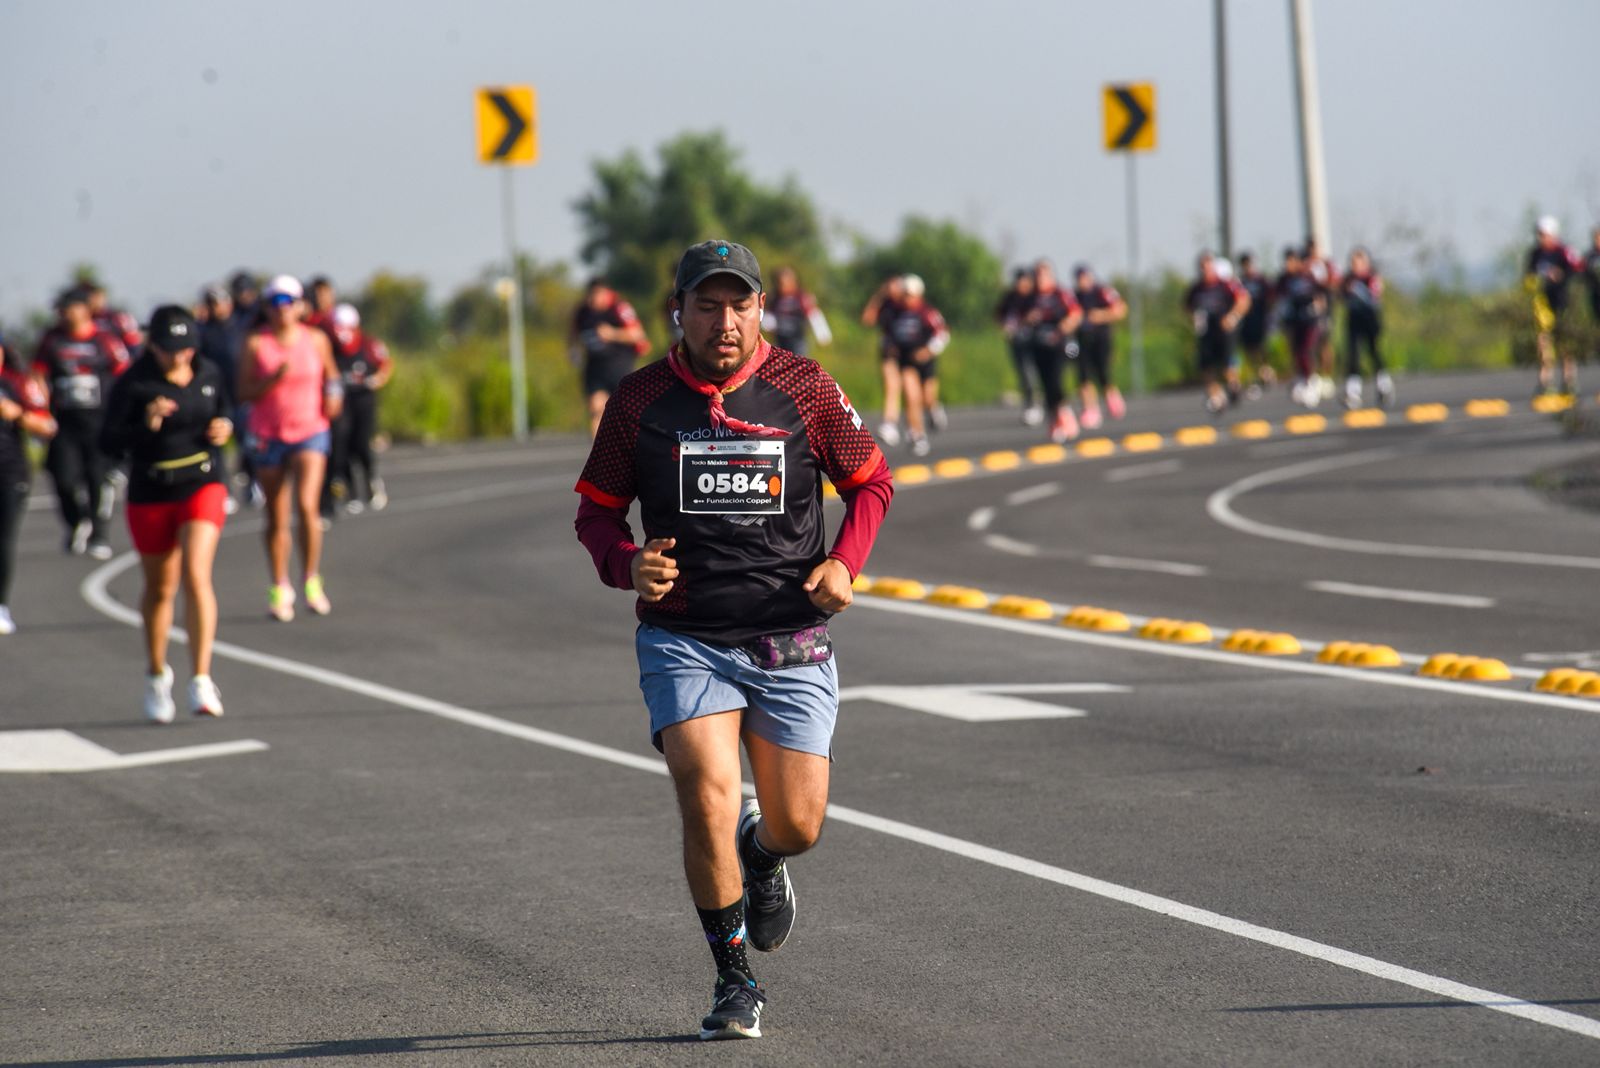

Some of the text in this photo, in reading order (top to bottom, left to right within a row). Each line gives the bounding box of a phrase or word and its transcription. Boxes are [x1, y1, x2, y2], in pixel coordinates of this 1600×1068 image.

[676, 428, 711, 442] Todo
[697, 473, 768, 494] 0584
[746, 497, 772, 505] Coppel
